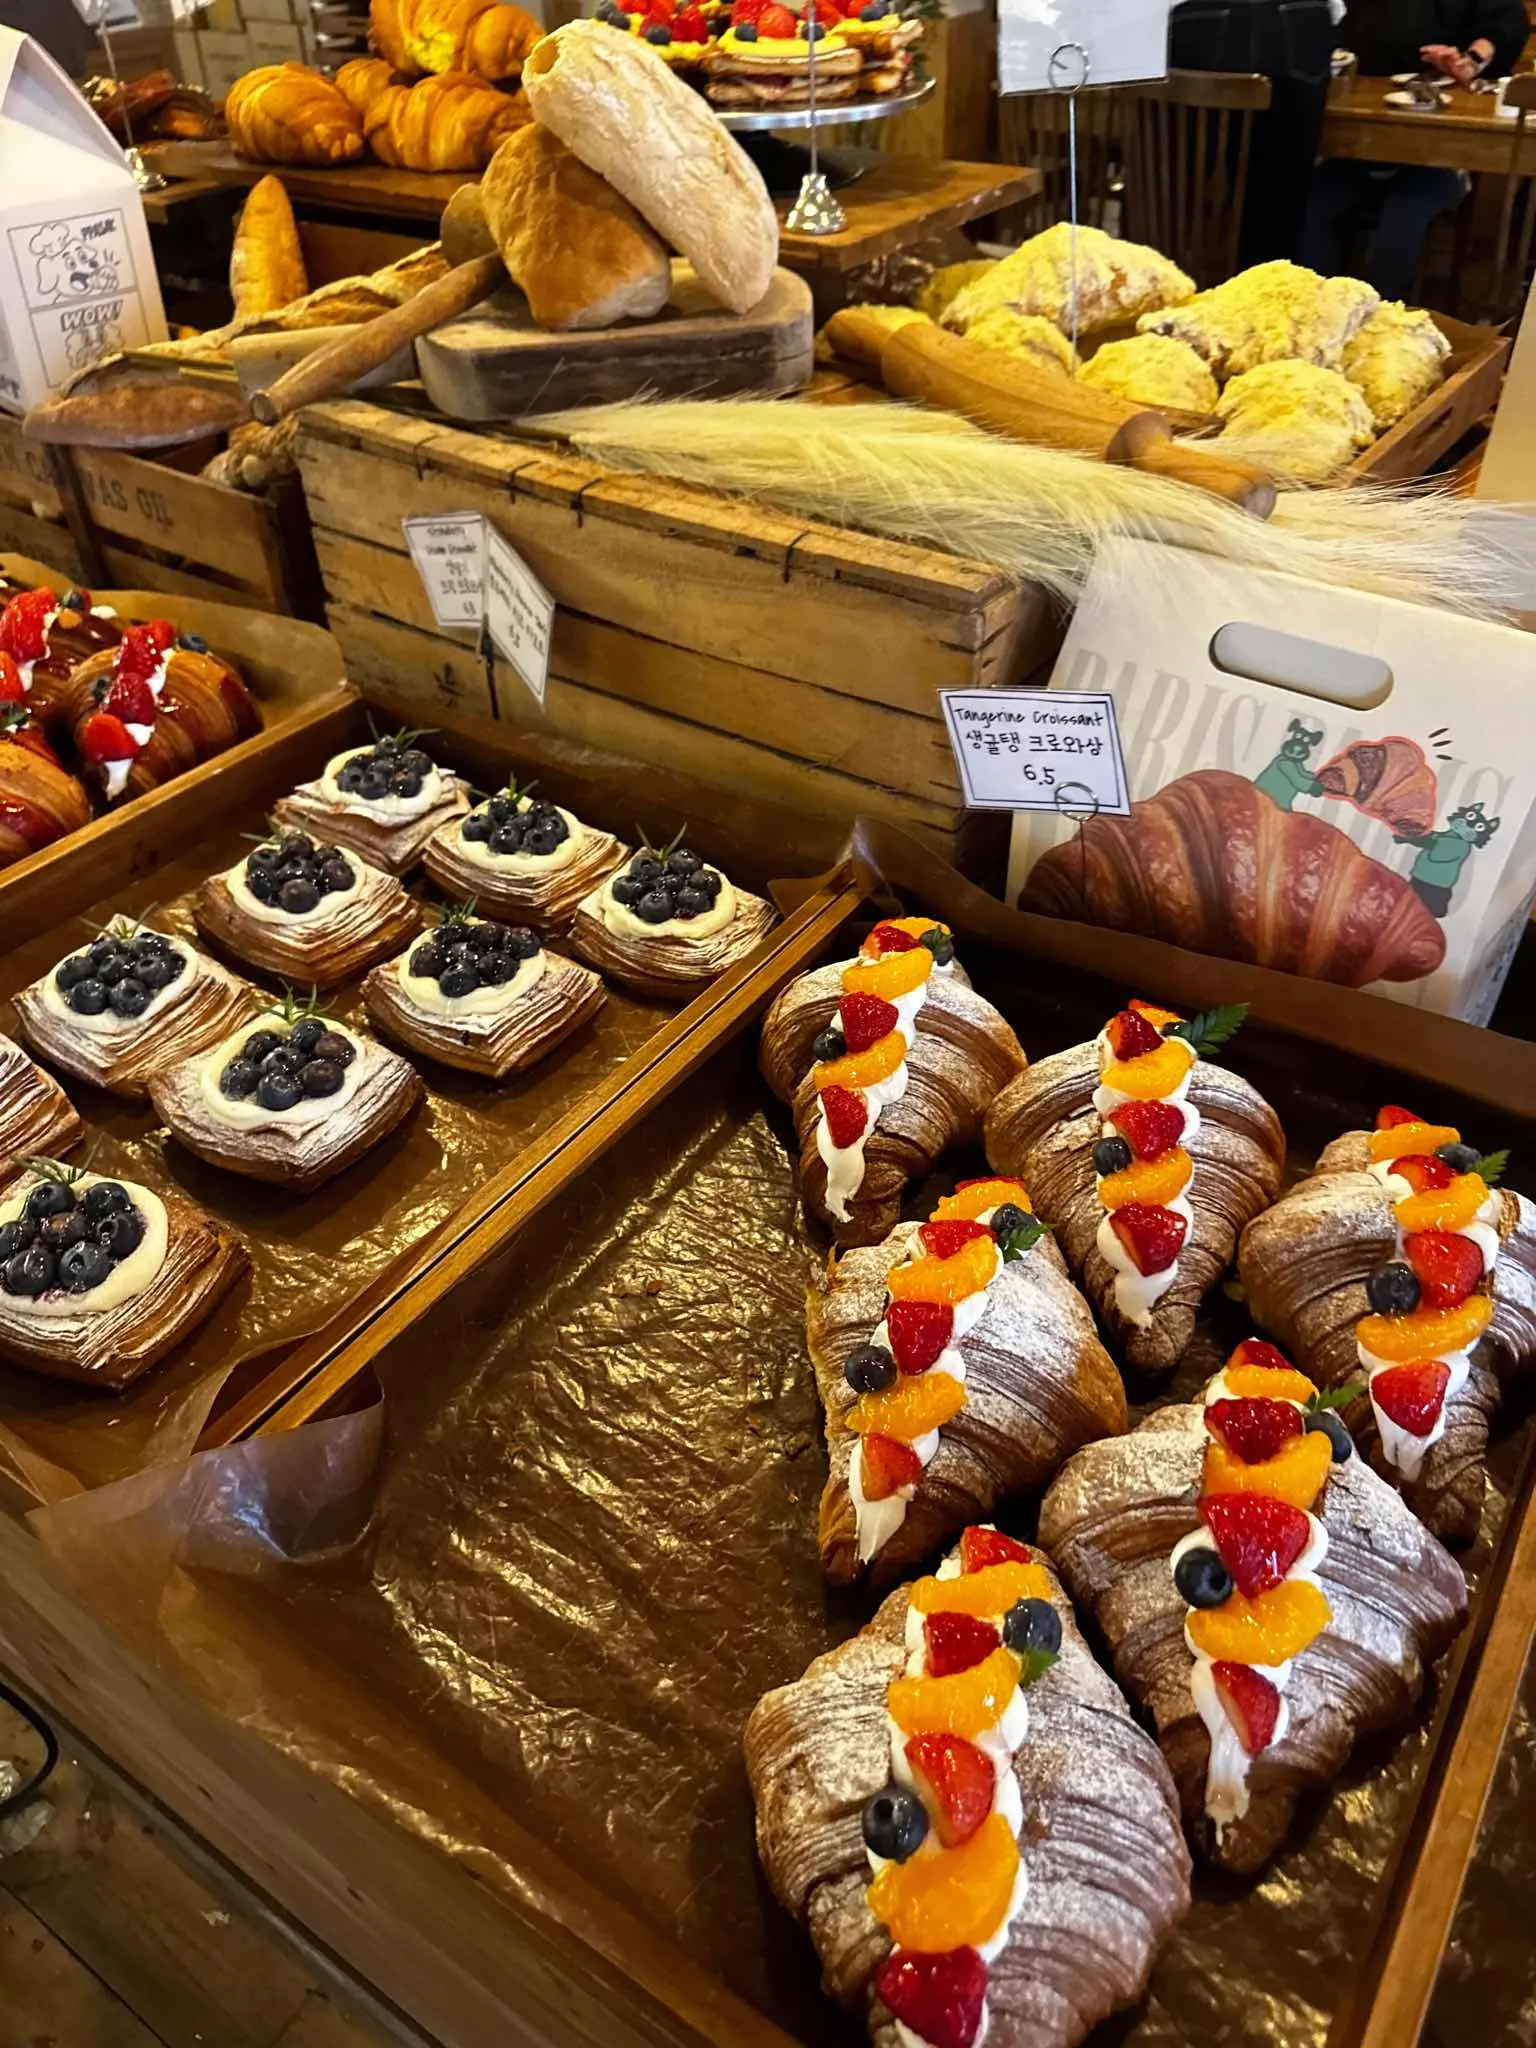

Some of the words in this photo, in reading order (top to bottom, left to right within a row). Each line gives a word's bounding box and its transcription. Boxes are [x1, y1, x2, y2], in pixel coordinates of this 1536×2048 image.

[60, 299, 123, 332] WOW!
[954, 706, 1026, 728] Tangerine
[1033, 709, 1104, 727] Croissant
[965, 728, 1021, 755] 생귤탱
[1028, 733, 1104, 756] 크로와상
[1023, 764, 1056, 786] 6.5
